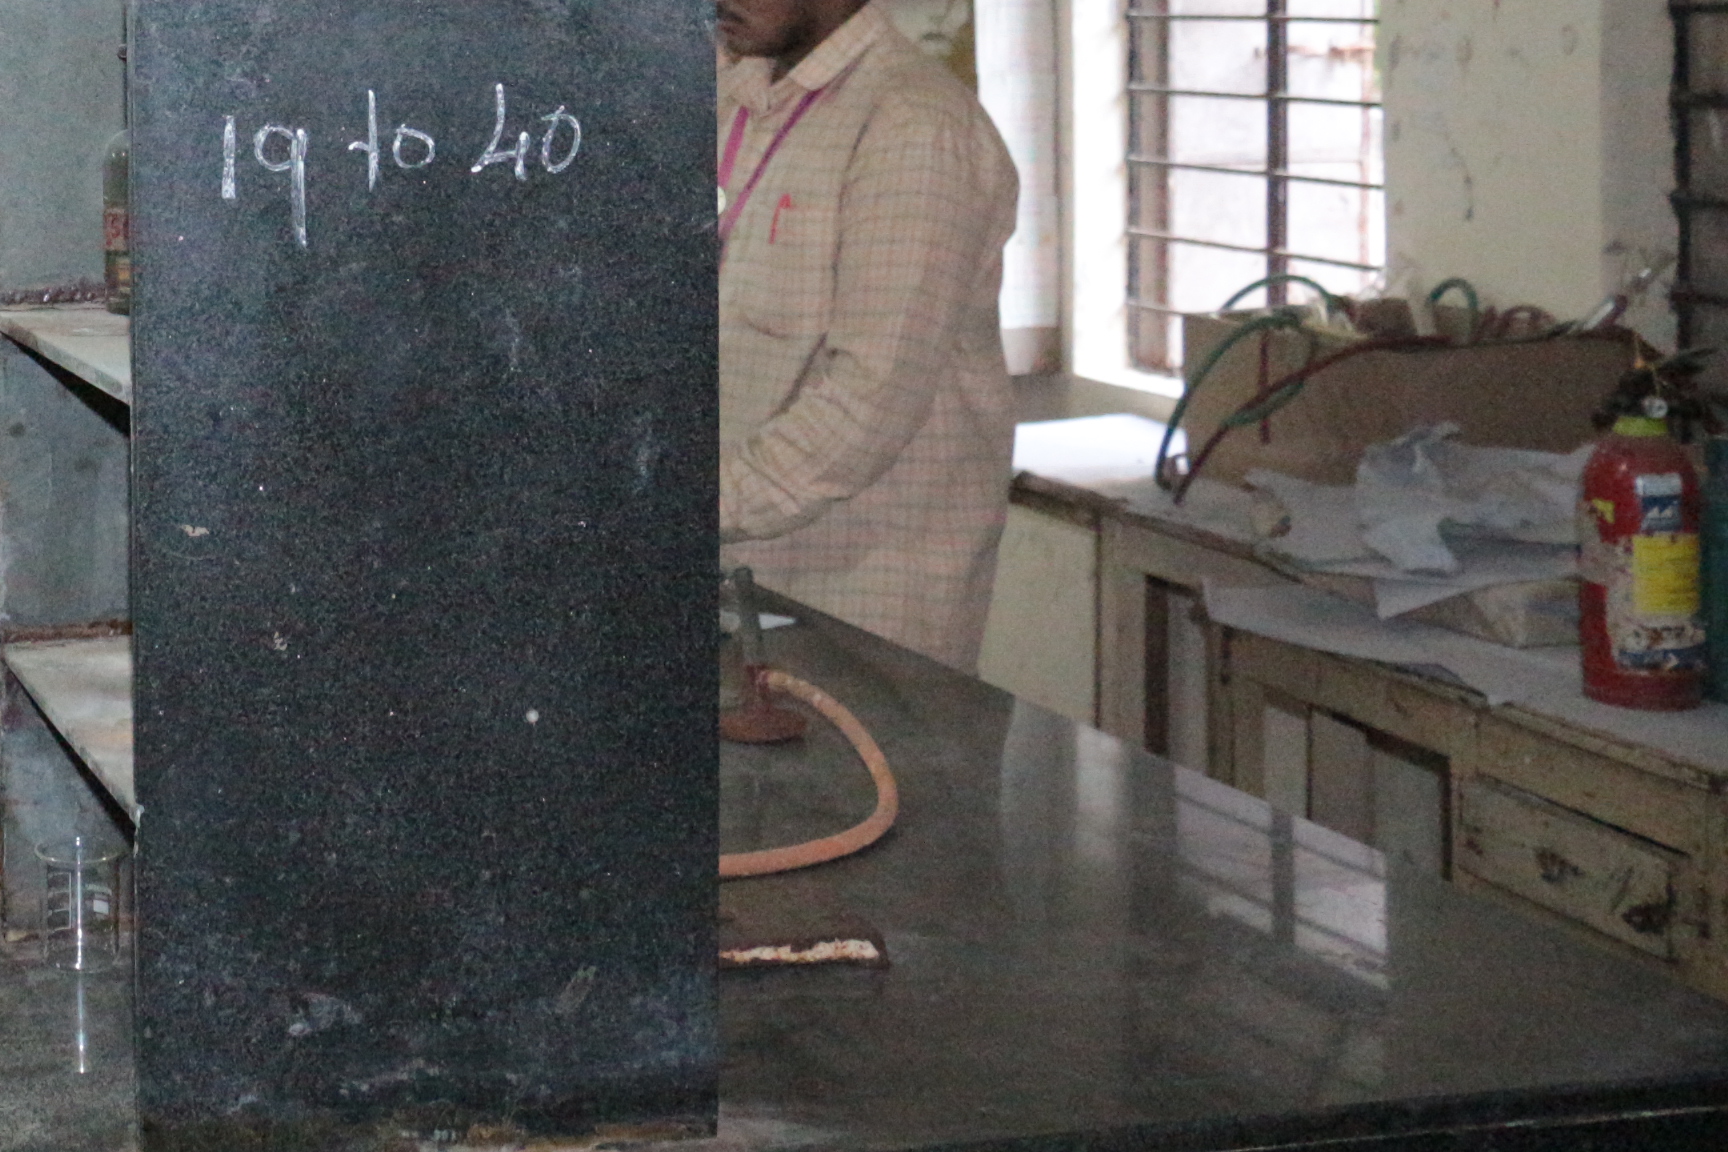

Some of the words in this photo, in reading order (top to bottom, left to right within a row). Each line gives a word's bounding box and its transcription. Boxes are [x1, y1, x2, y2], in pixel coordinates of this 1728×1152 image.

[221, 114, 308, 248] 19
[348, 89, 435, 193] to
[471, 82, 582, 180] 40
